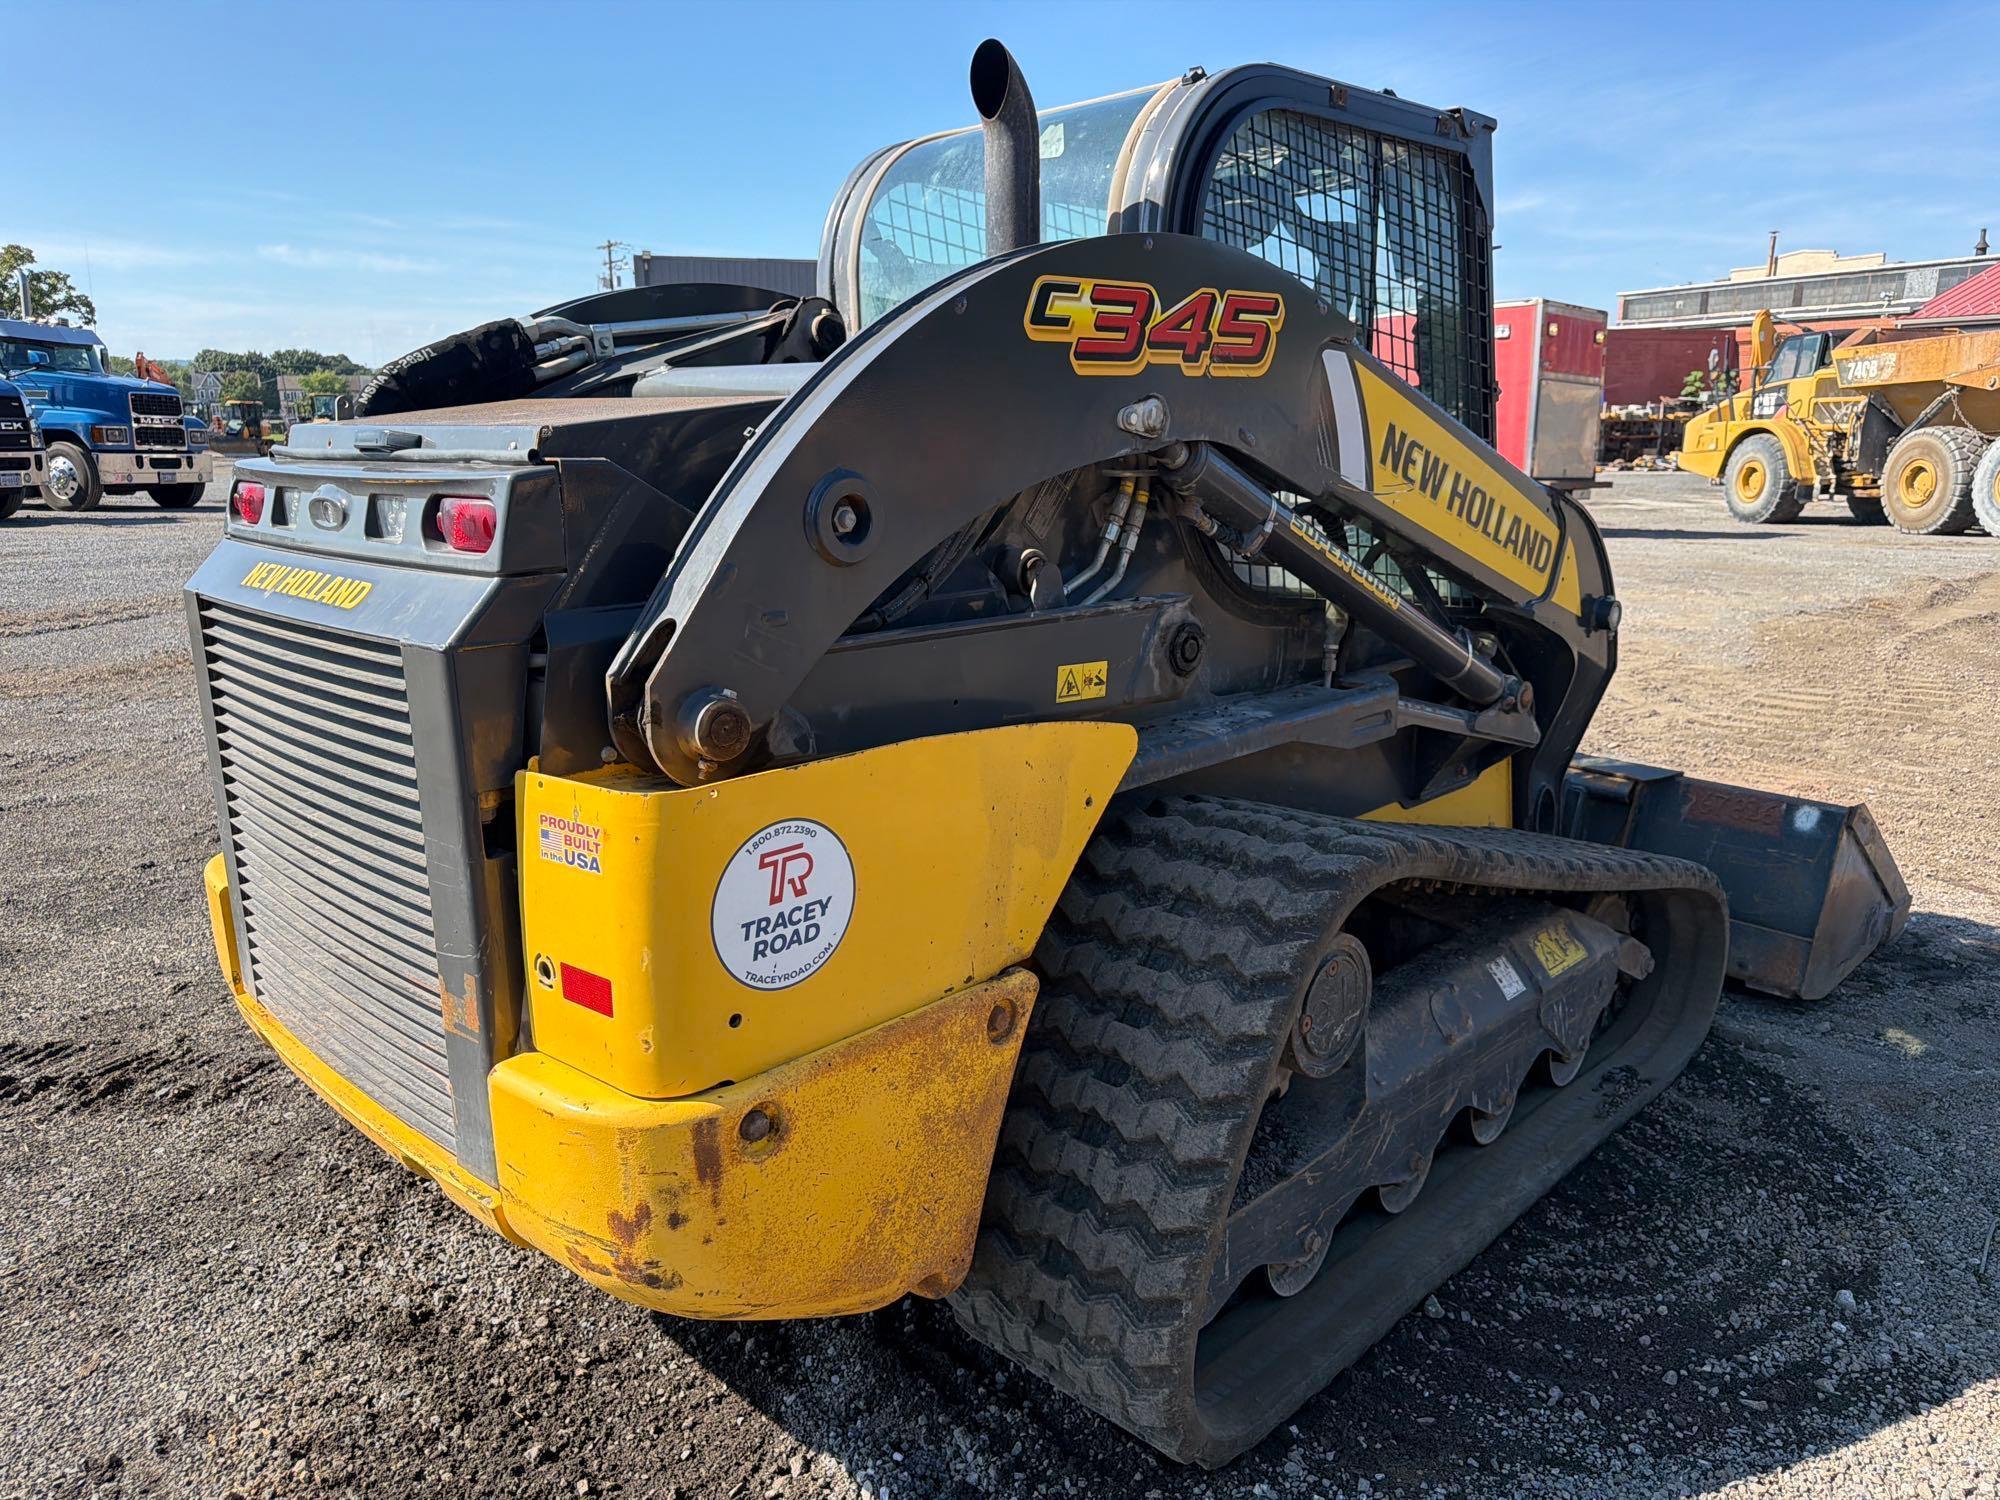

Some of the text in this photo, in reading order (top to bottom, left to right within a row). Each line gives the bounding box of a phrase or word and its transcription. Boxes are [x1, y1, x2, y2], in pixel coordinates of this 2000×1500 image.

[358, 375, 388, 404] MSHA
[1379, 422, 1552, 574] NEW HOLLAND
[240, 561, 373, 610] NEW HOLLAND
[540, 814, 600, 839] PROUDLY
[564, 834, 601, 854] BUILT
[745, 825, 817, 856] 1.800.872.2390
[550, 852, 563, 863] the
[564, 849, 601, 873] USA
[741, 895, 832, 942] TRACEY
[753, 922, 820, 962] ROAD
[745, 942, 834, 984] TRACEYROAD.COM
